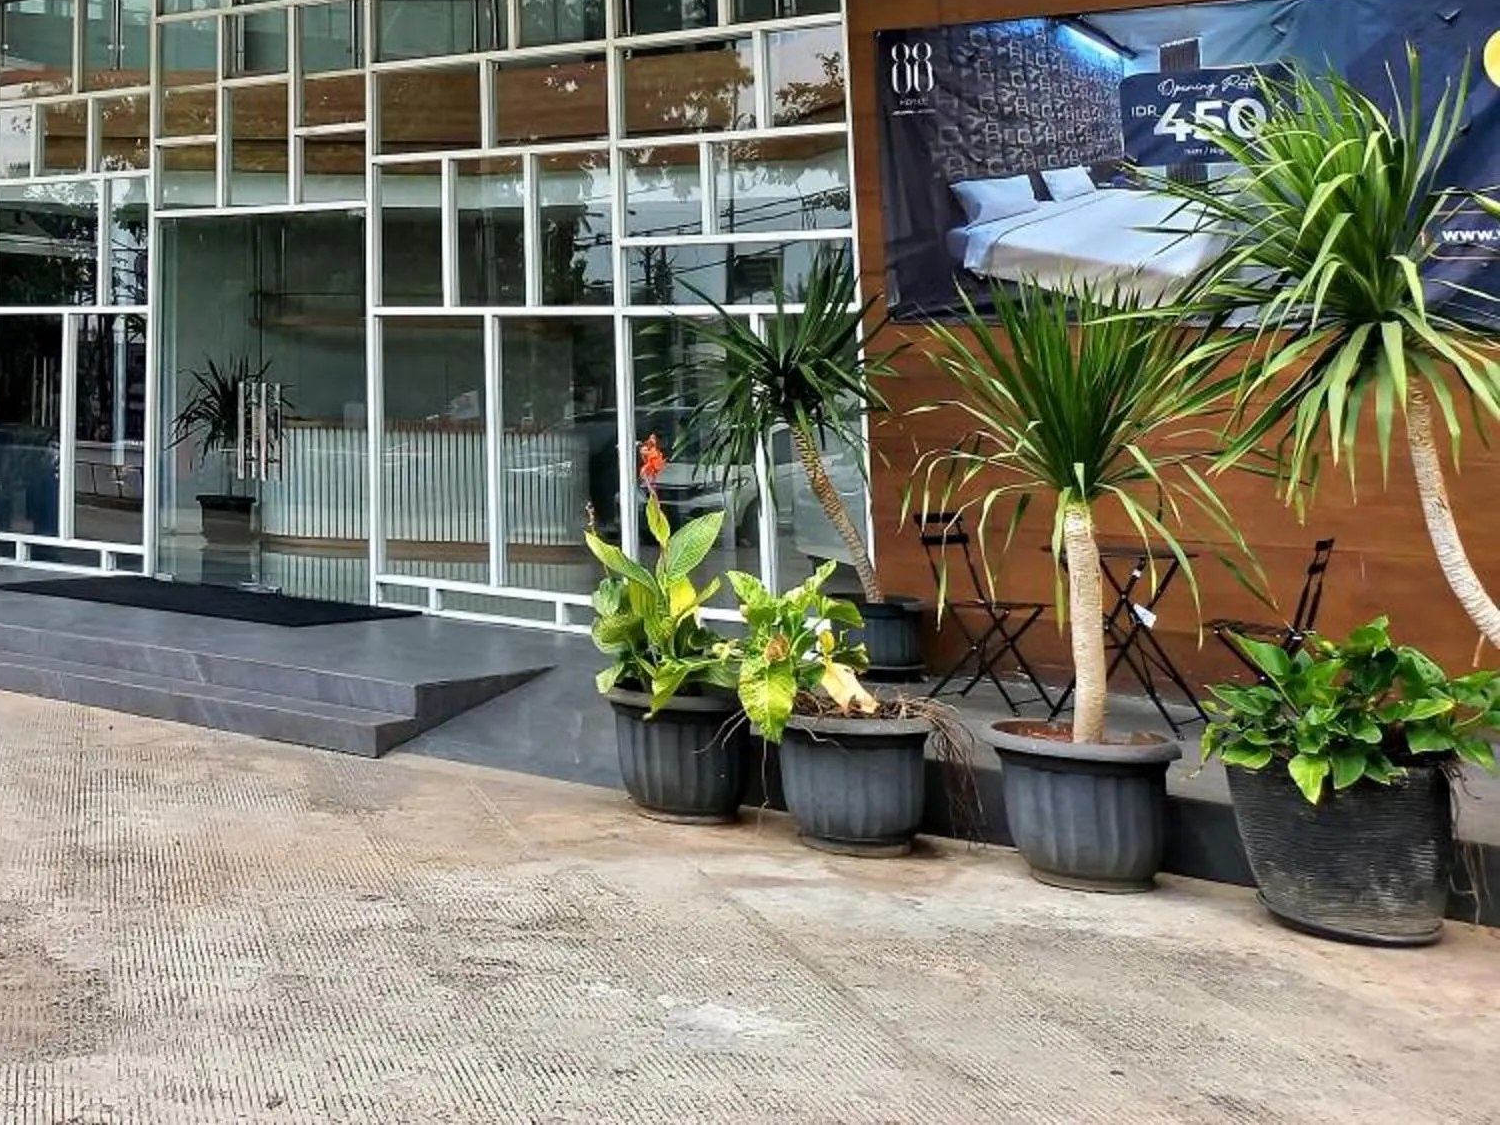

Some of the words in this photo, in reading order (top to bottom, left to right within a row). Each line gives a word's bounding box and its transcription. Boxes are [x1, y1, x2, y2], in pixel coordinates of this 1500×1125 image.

[891, 42, 934, 94] 88
[1158, 78, 1217, 98] Opening
[1131, 105, 1159, 118] IDR
[1153, 97, 1267, 142] 450
